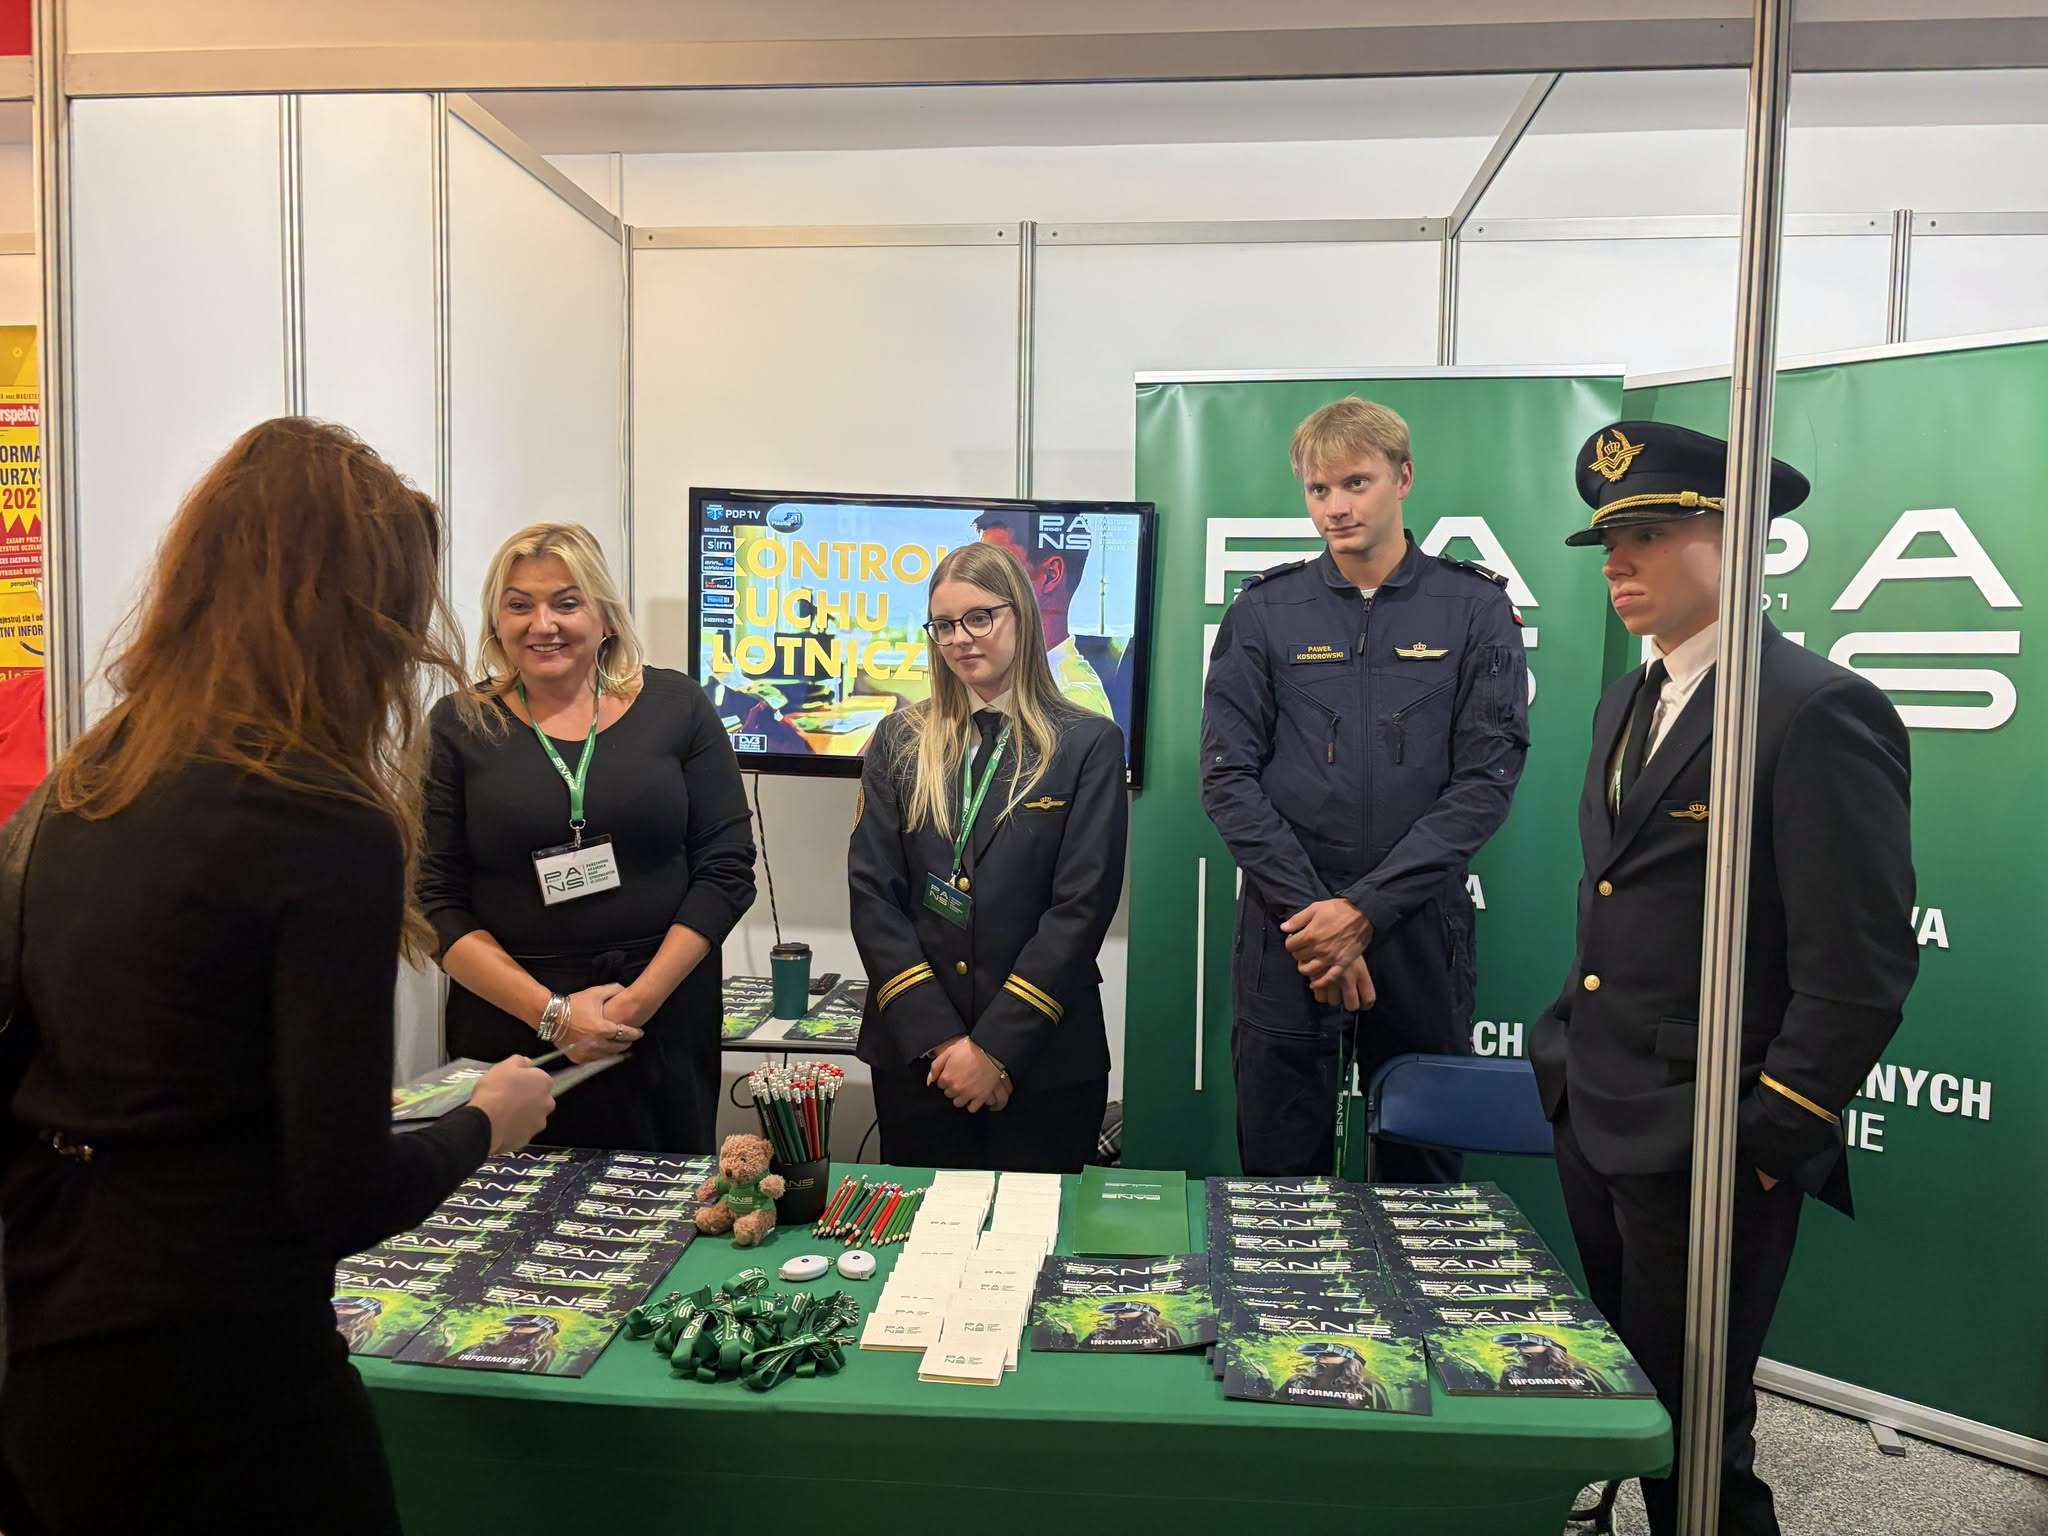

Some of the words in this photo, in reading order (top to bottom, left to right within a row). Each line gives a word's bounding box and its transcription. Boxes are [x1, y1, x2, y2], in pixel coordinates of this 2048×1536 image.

[0, 467, 40, 486] URZY
[2, 487, 40, 509] 202
[725, 509, 745, 519] PDP
[748, 510, 761, 519] TV
[1296, 651, 1344, 660] KOSIOROWSKI
[1856, 1062, 1992, 1121] NYCH
[502, 1151, 571, 1162] ANS
[478, 1165, 556, 1177] ANS
[460, 1181, 542, 1193] ANS
[444, 1196, 530, 1209] ANS
[423, 1215, 512, 1229] ANS
[392, 1235, 485, 1249] ANS
[1440, 1310, 1574, 1322] PANS
[1259, 1316, 1392, 1335] PANS
[1090, 1338, 1159, 1346] INFORMATOR
[458, 1353, 529, 1365] INFORMATOR
[1509, 1378, 1584, 1386] INFORMATOR
[1288, 1387, 1363, 1401] INFORMATOR
